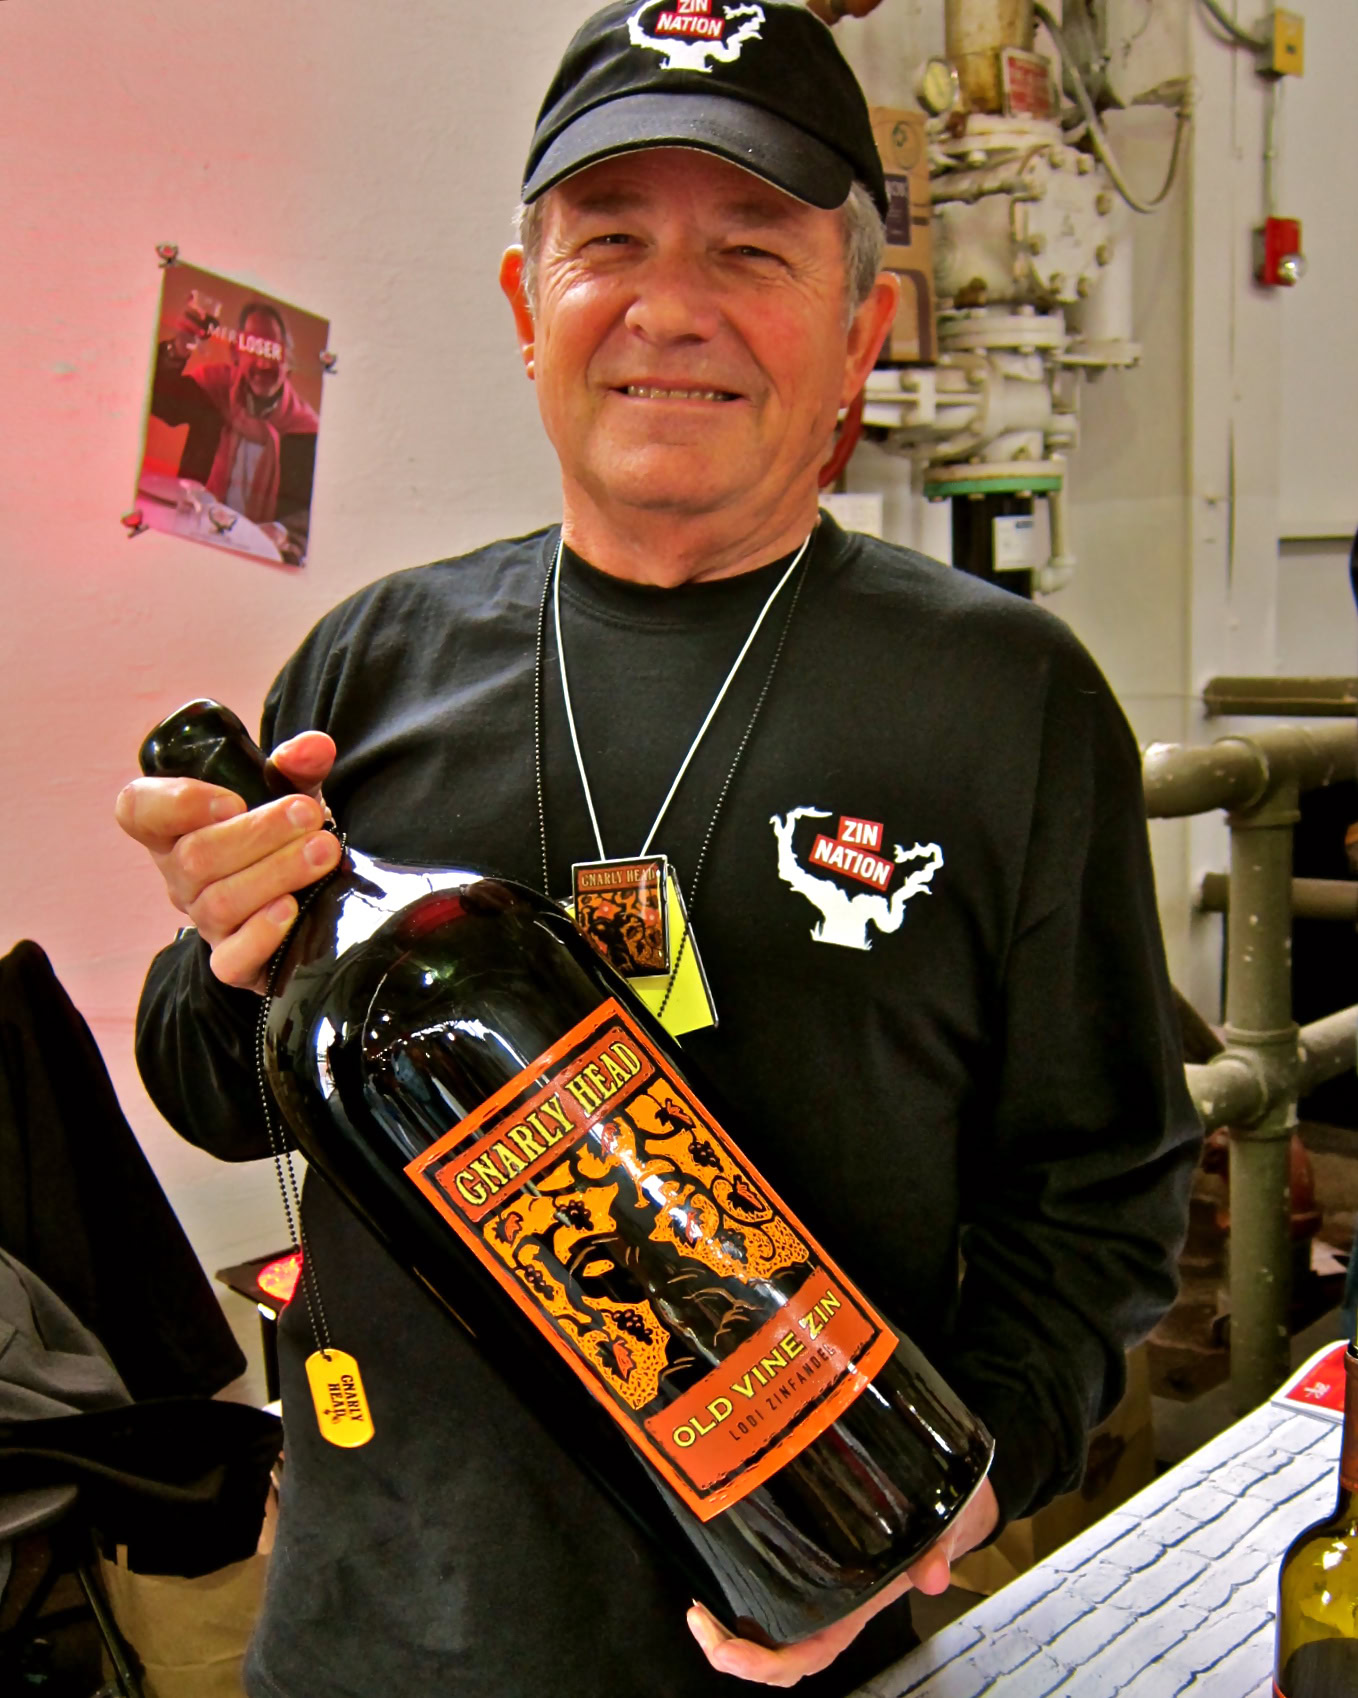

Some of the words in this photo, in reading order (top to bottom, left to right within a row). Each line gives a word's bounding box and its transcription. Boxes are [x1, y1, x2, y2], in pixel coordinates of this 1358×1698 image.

[678, 0, 708, 13] ZIN
[657, 13, 723, 37] NATION
[238, 333, 283, 360] LOSER
[841, 820, 879, 847] ZIN
[581, 870, 624, 887] GNARLY
[626, 866, 656, 883] HEAD
[814, 839, 891, 886] NATION
[455, 1096, 574, 1205] GNARLY
[565, 1040, 642, 1118] HEAD
[672, 1395, 734, 1448] OLD
[731, 1331, 806, 1399] VINE
[798, 1290, 842, 1340] ZIN
[328, 1383, 346, 1417] HEAD
[340, 1374, 364, 1422] GNARLY
[728, 1409, 765, 1441] LODI
[766, 1344, 835, 1411] ZINFANDEL
